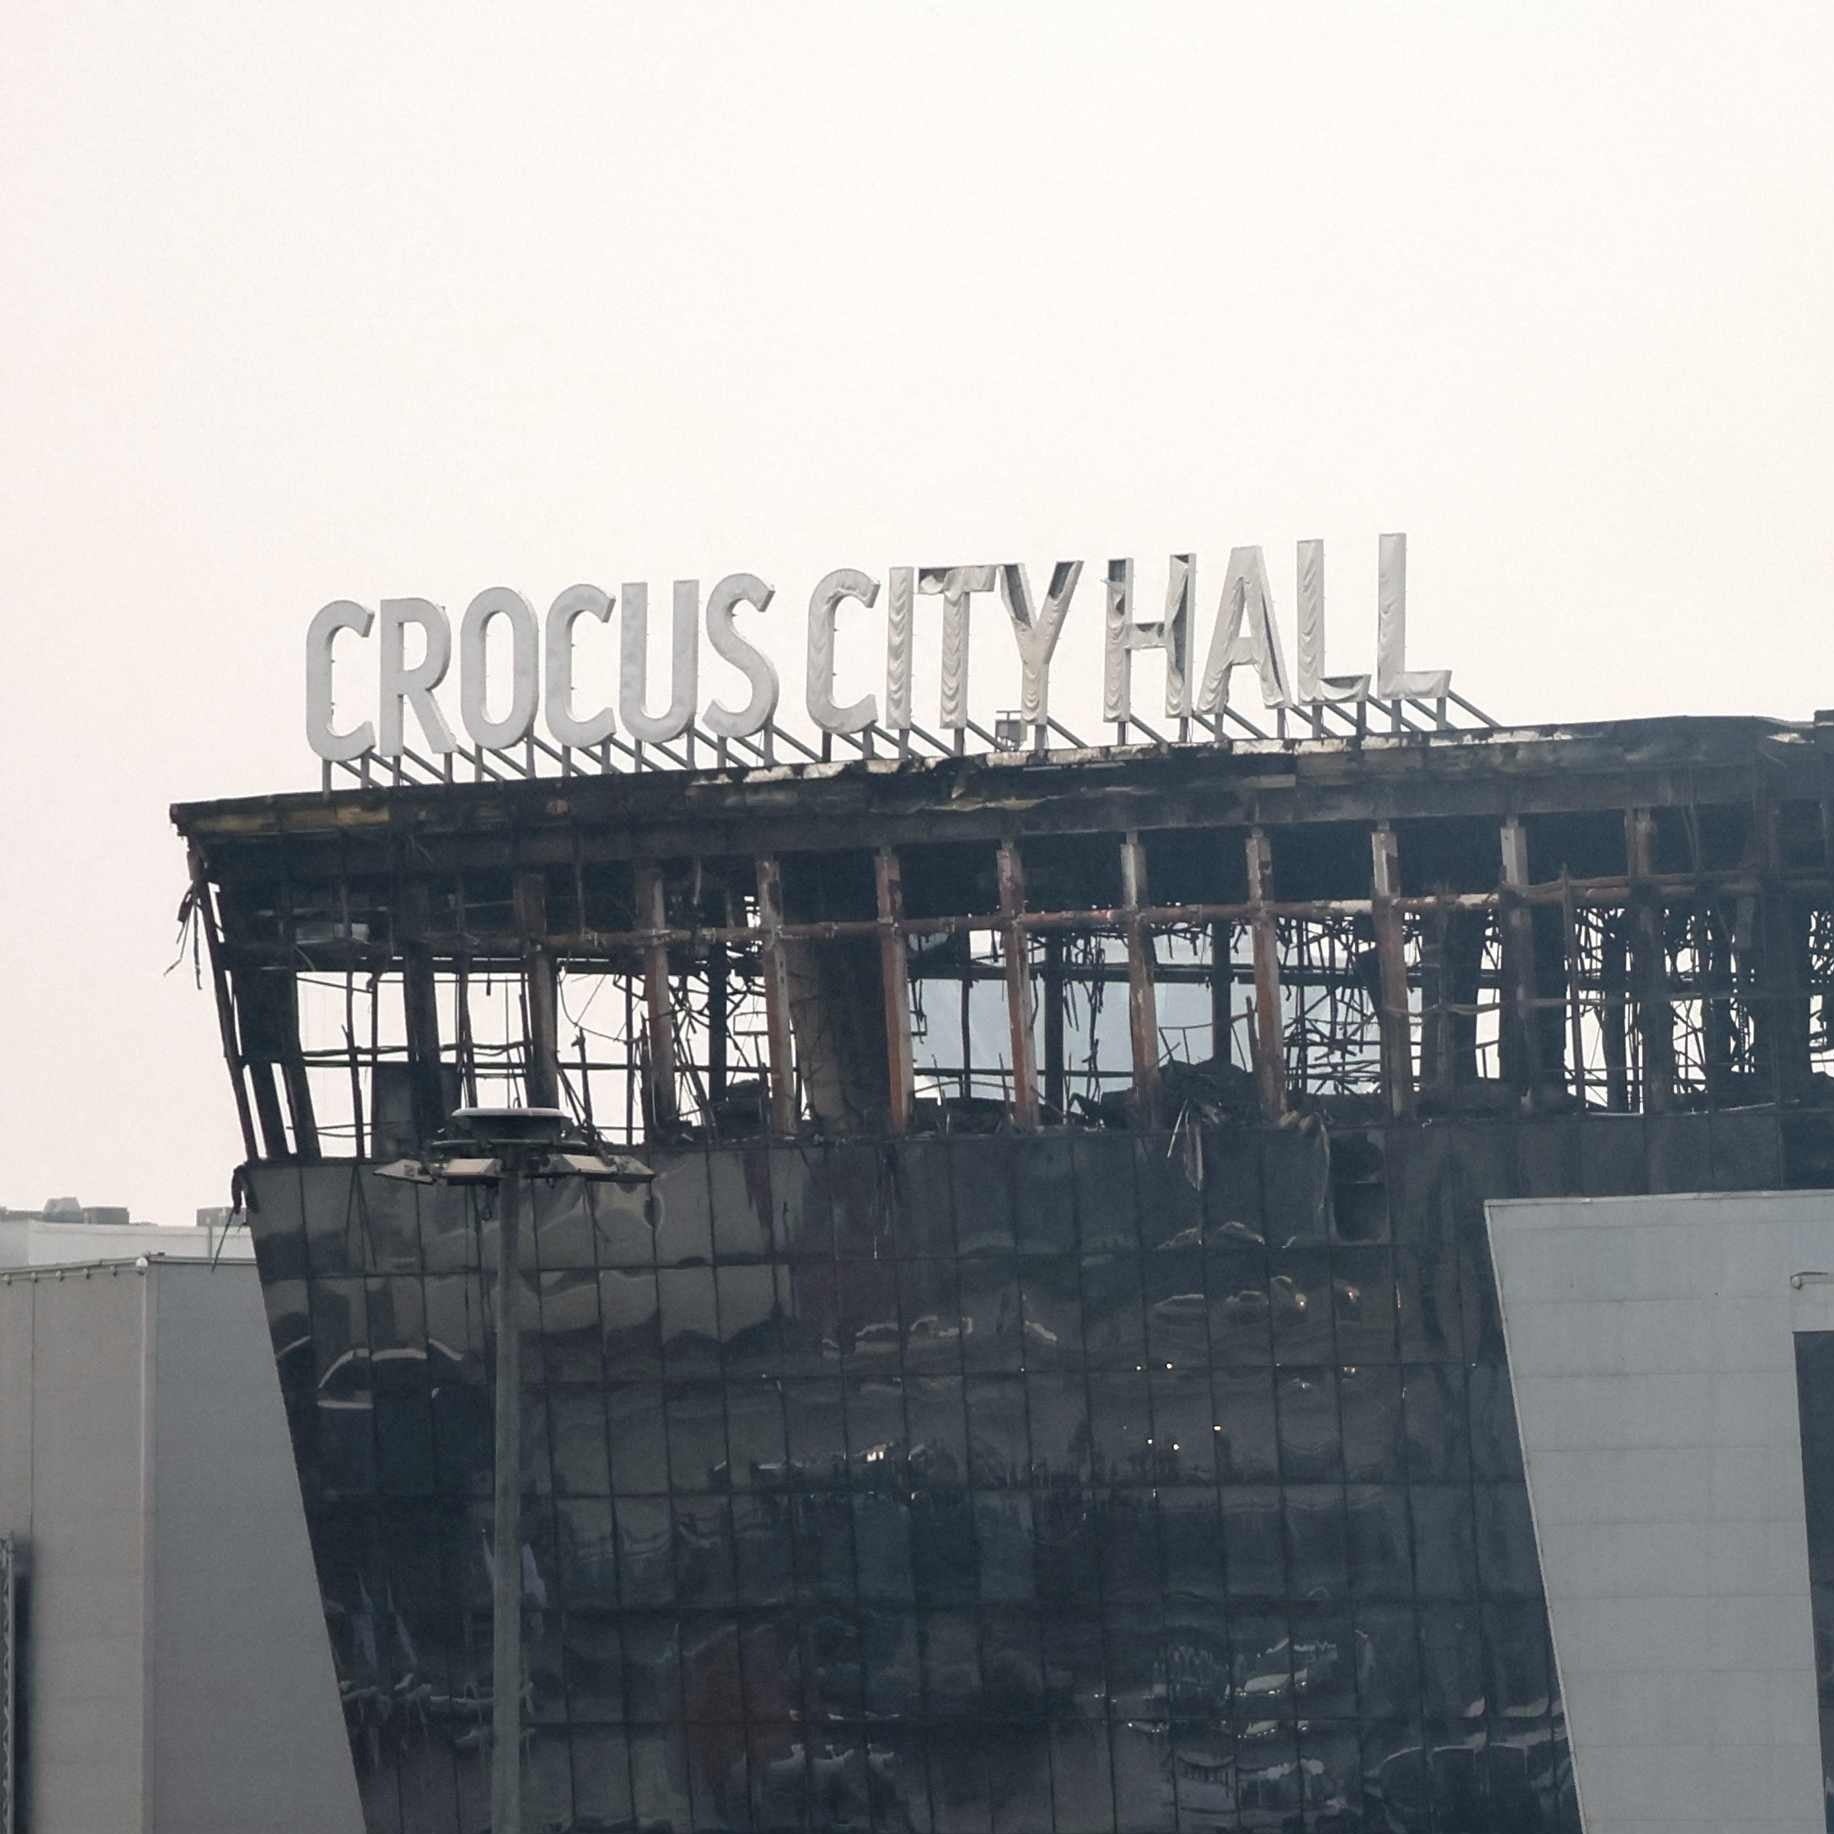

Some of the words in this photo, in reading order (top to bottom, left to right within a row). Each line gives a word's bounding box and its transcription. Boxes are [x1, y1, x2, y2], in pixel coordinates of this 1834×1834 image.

[305, 572, 779, 762] CROCUS
[807, 560, 1084, 735] CITY
[1103, 532, 1452, 722] HALL
